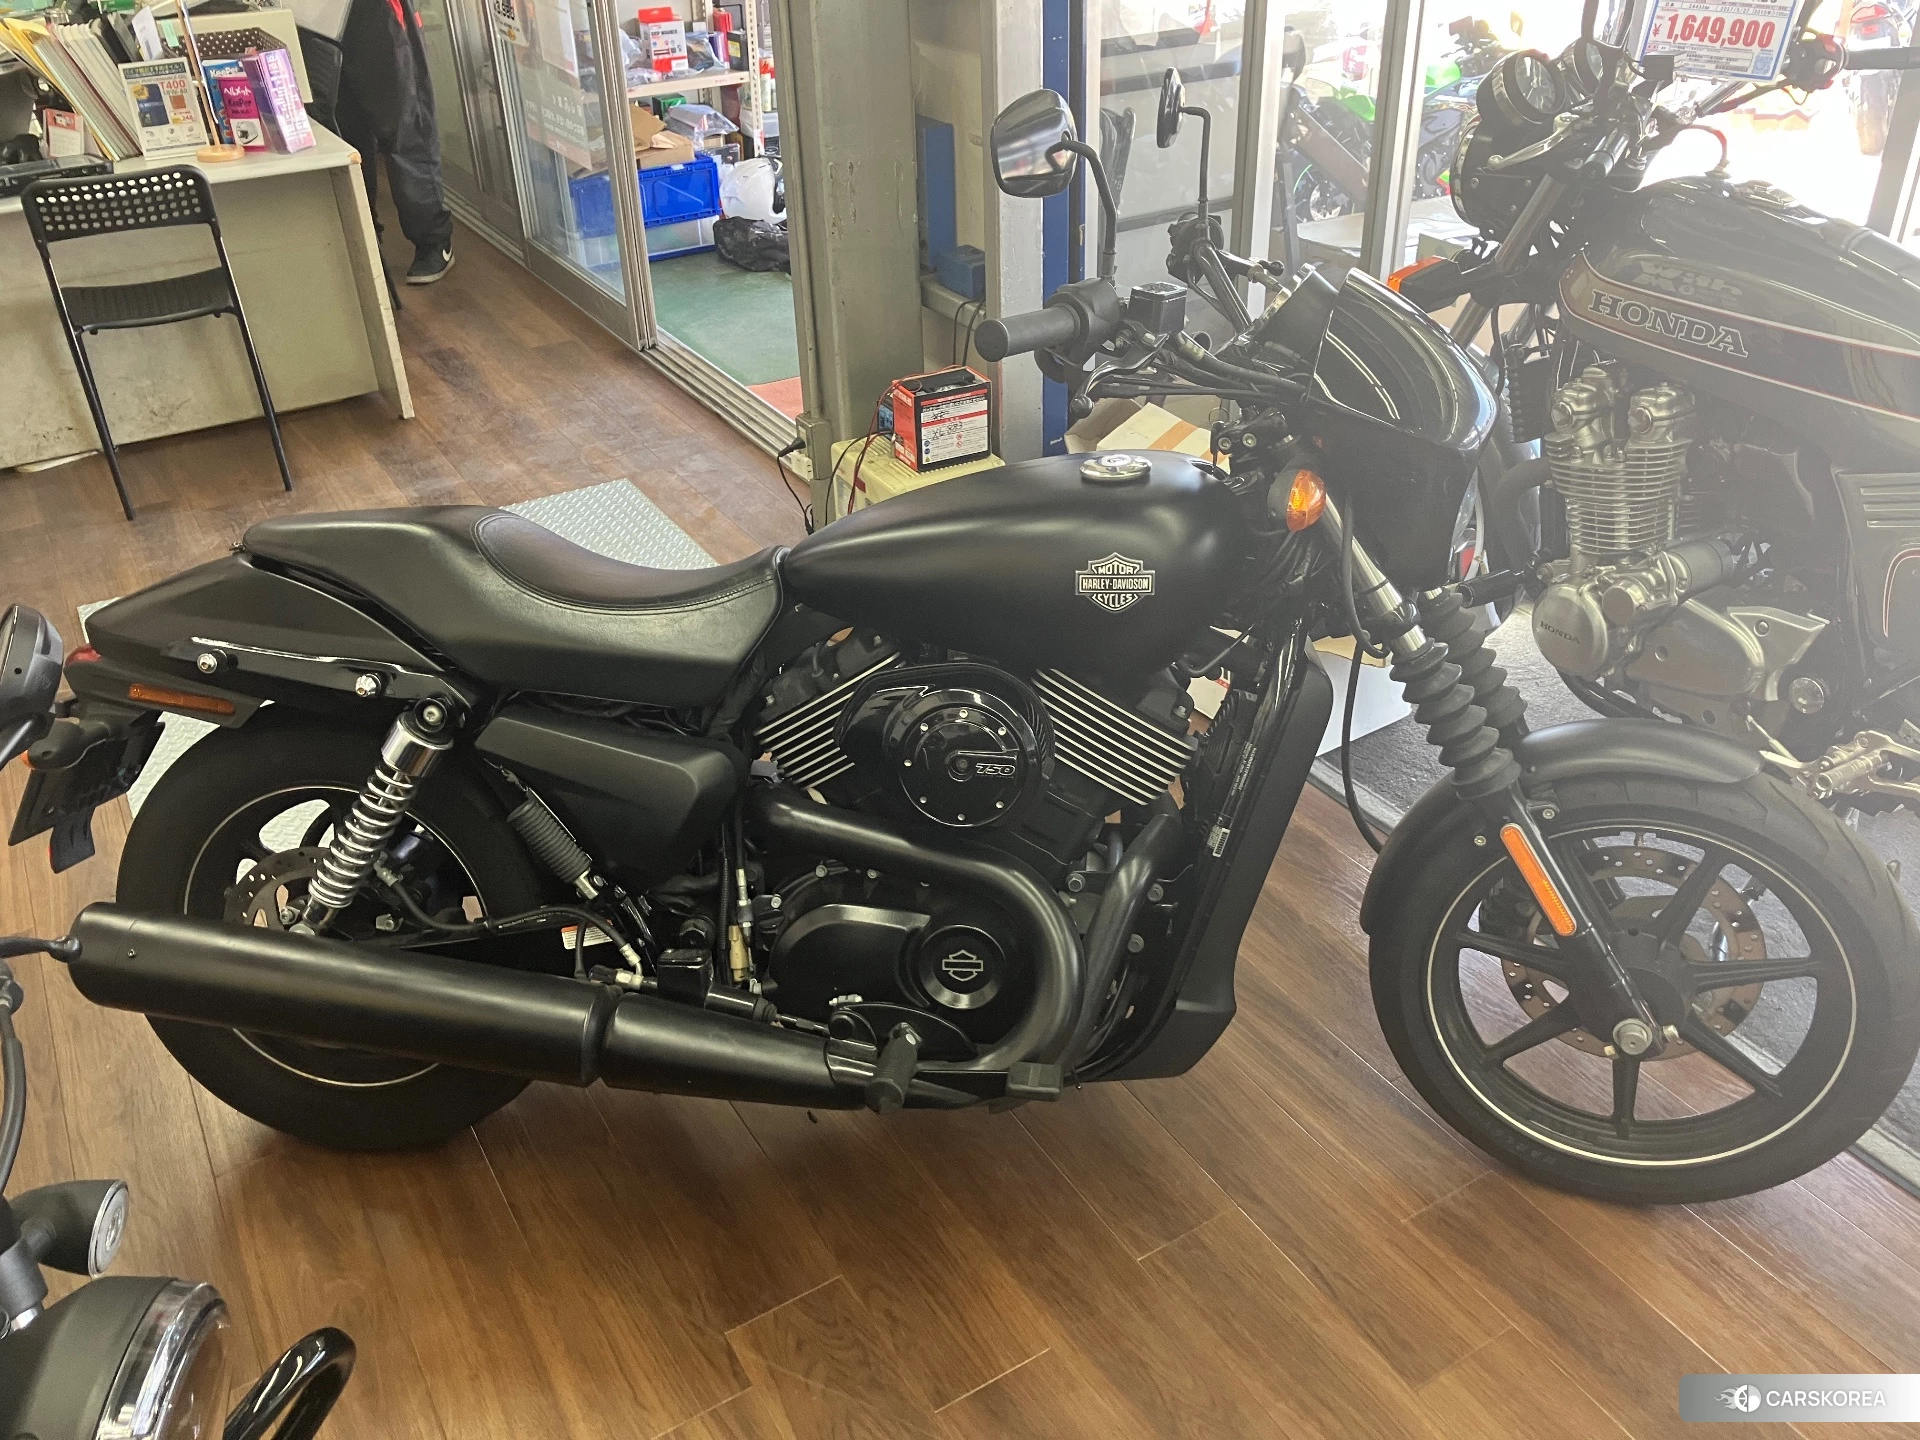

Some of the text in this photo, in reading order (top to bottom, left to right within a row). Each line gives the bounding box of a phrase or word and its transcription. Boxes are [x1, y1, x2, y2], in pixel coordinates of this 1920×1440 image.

[1652, 14, 1775, 48] ¥ 1,649,900
[1588, 289, 1749, 358] HONDA
[1099, 561, 1134, 574] MOTOR
[1082, 578, 1149, 590] HARLEY-DAVIDSON
[1097, 593, 1133, 607] CYCLES
[1540, 620, 1581, 645] HONDA
[975, 762, 1016, 776] 750
